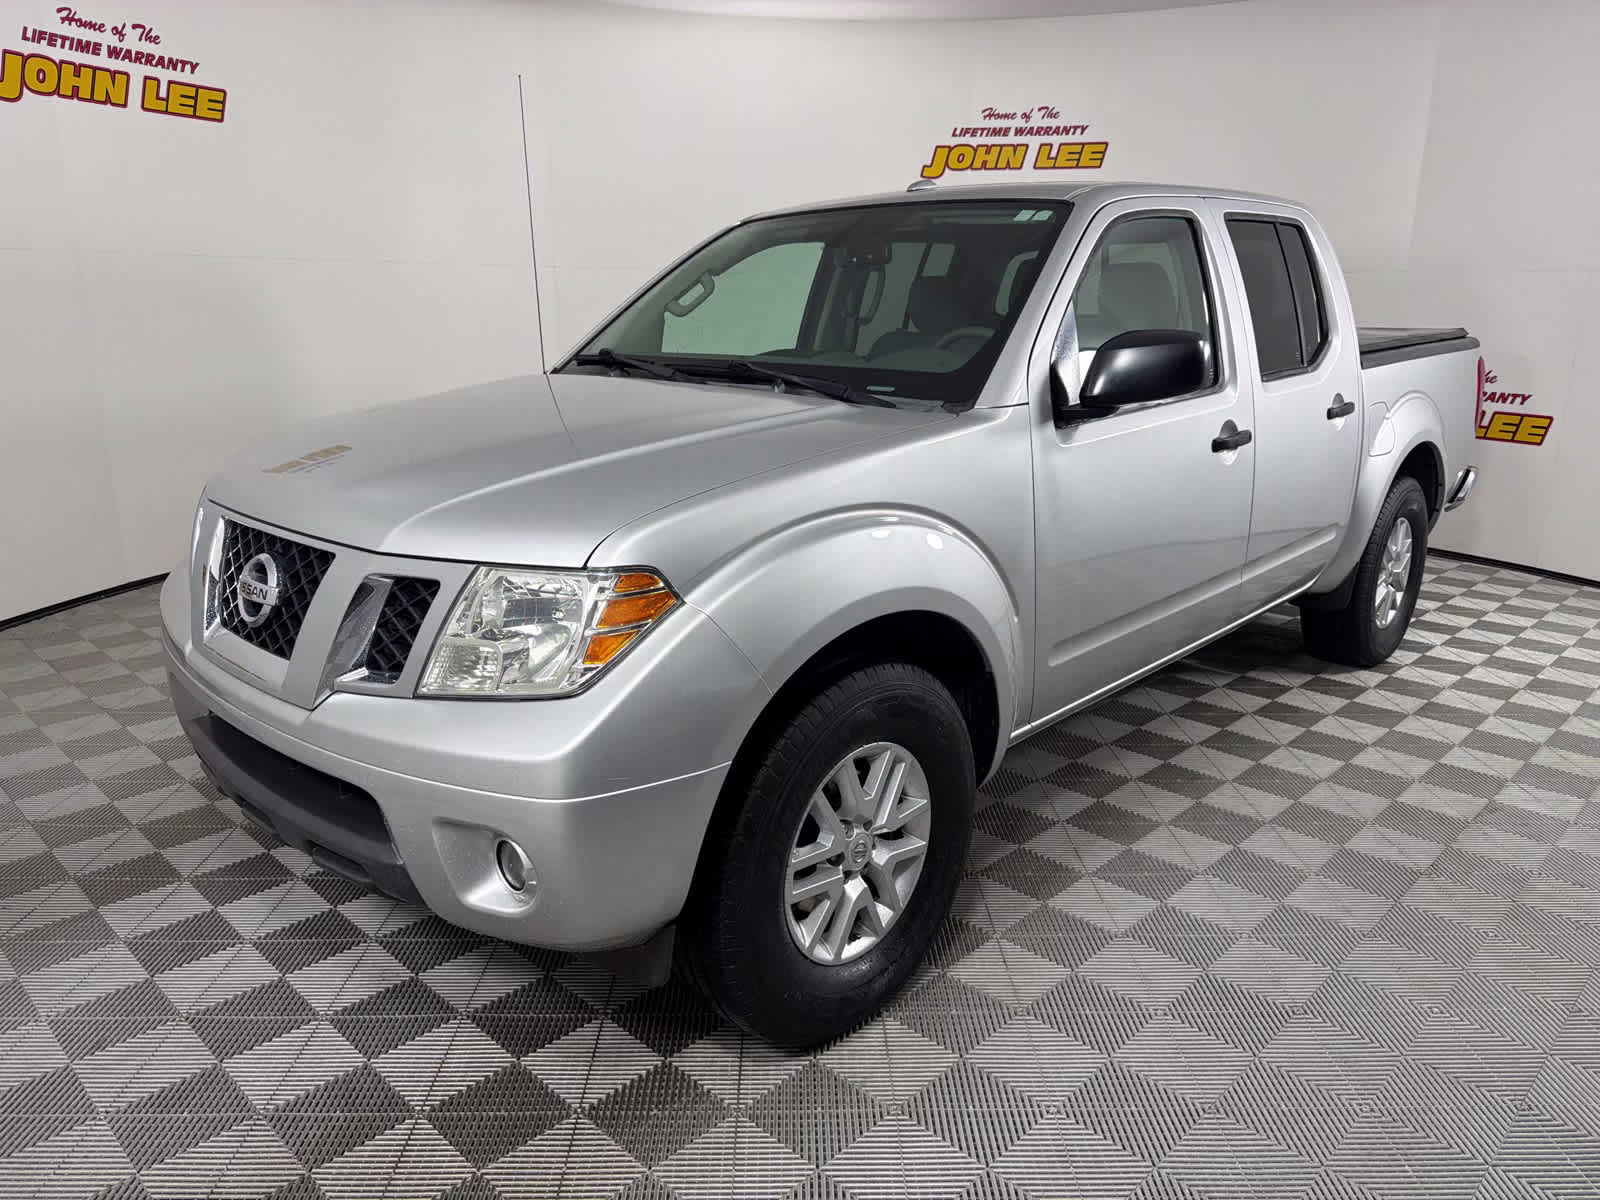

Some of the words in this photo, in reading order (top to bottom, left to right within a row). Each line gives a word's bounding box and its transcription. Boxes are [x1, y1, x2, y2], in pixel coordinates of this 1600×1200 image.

[56, 6, 106, 33] Home
[111, 23, 126, 42] of
[131, 23, 161, 45] The
[21, 26, 102, 56] LIFETIME
[106, 44, 200, 74] WARRANTY
[0, 49, 130, 108] JOHN
[141, 75, 227, 123] LEE
[951, 127, 1011, 138] LIFETIME
[1013, 125, 1089, 137] WARRANTY
[981, 107, 1017, 121] Home
[1020, 109, 1033, 124] of
[1037, 106, 1060, 120] The
[920, 143, 1029, 179] JOHN
[1033, 142, 1109, 169] LEE
